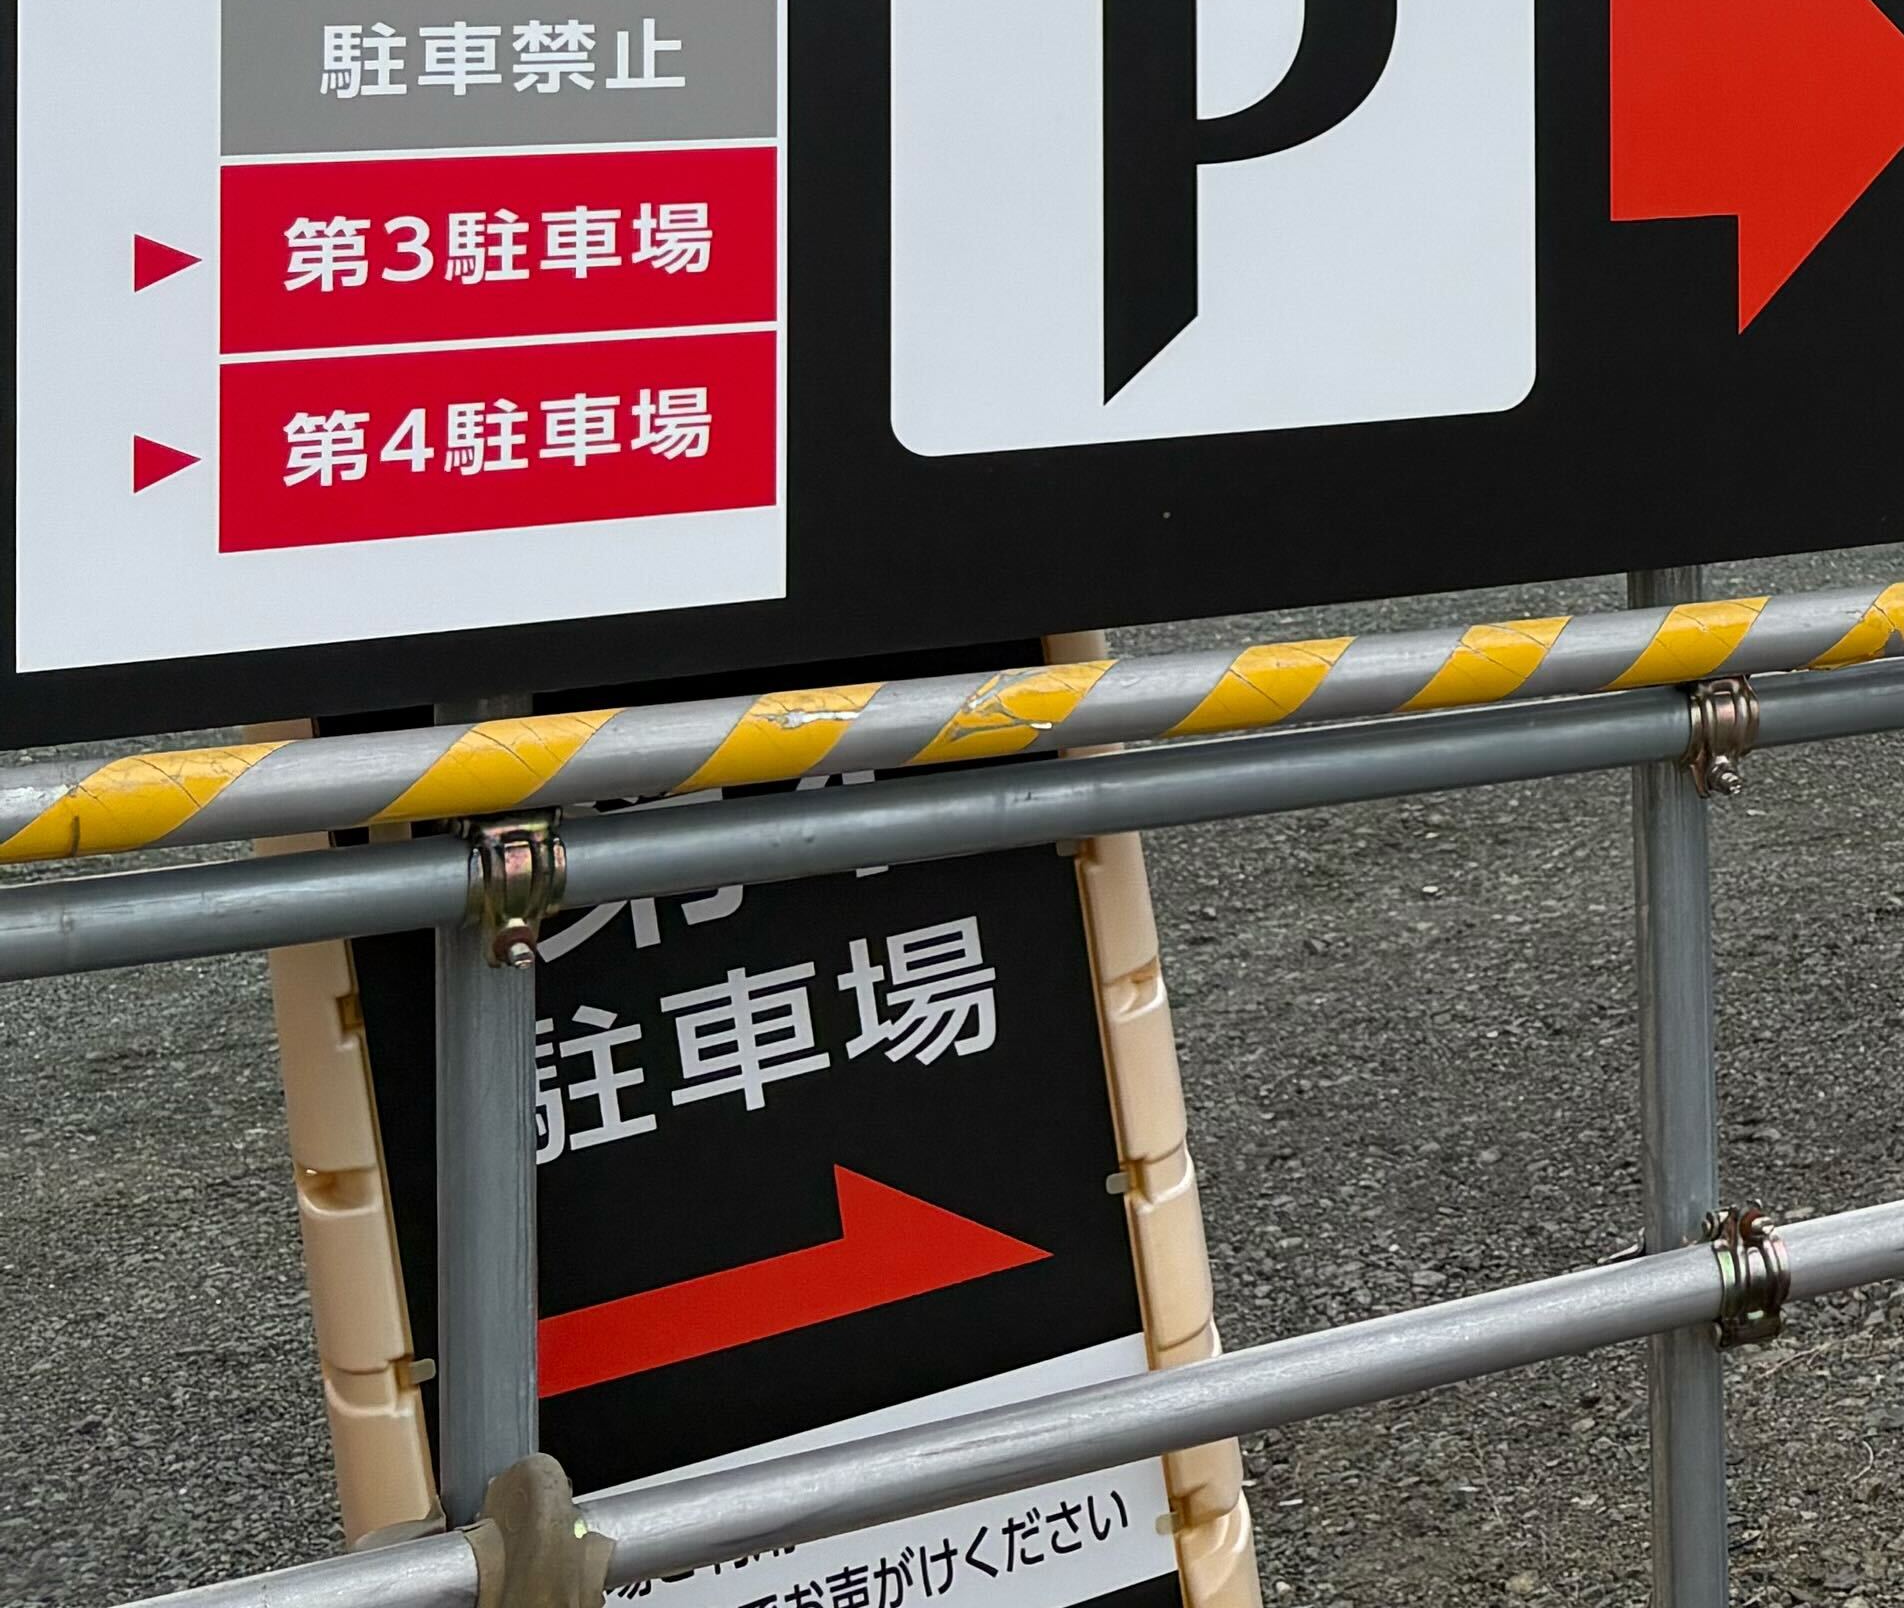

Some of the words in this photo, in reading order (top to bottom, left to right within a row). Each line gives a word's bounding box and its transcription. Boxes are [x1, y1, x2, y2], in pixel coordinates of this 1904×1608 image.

[319, 18, 686, 99] 駐車禁止
[284, 202, 713, 292] 第3駐車場
[283, 387, 712, 487] 第4駐車場
[536, 915, 996, 1166] 駐車場
[738, 1489, 1130, 1608] お声がけください
